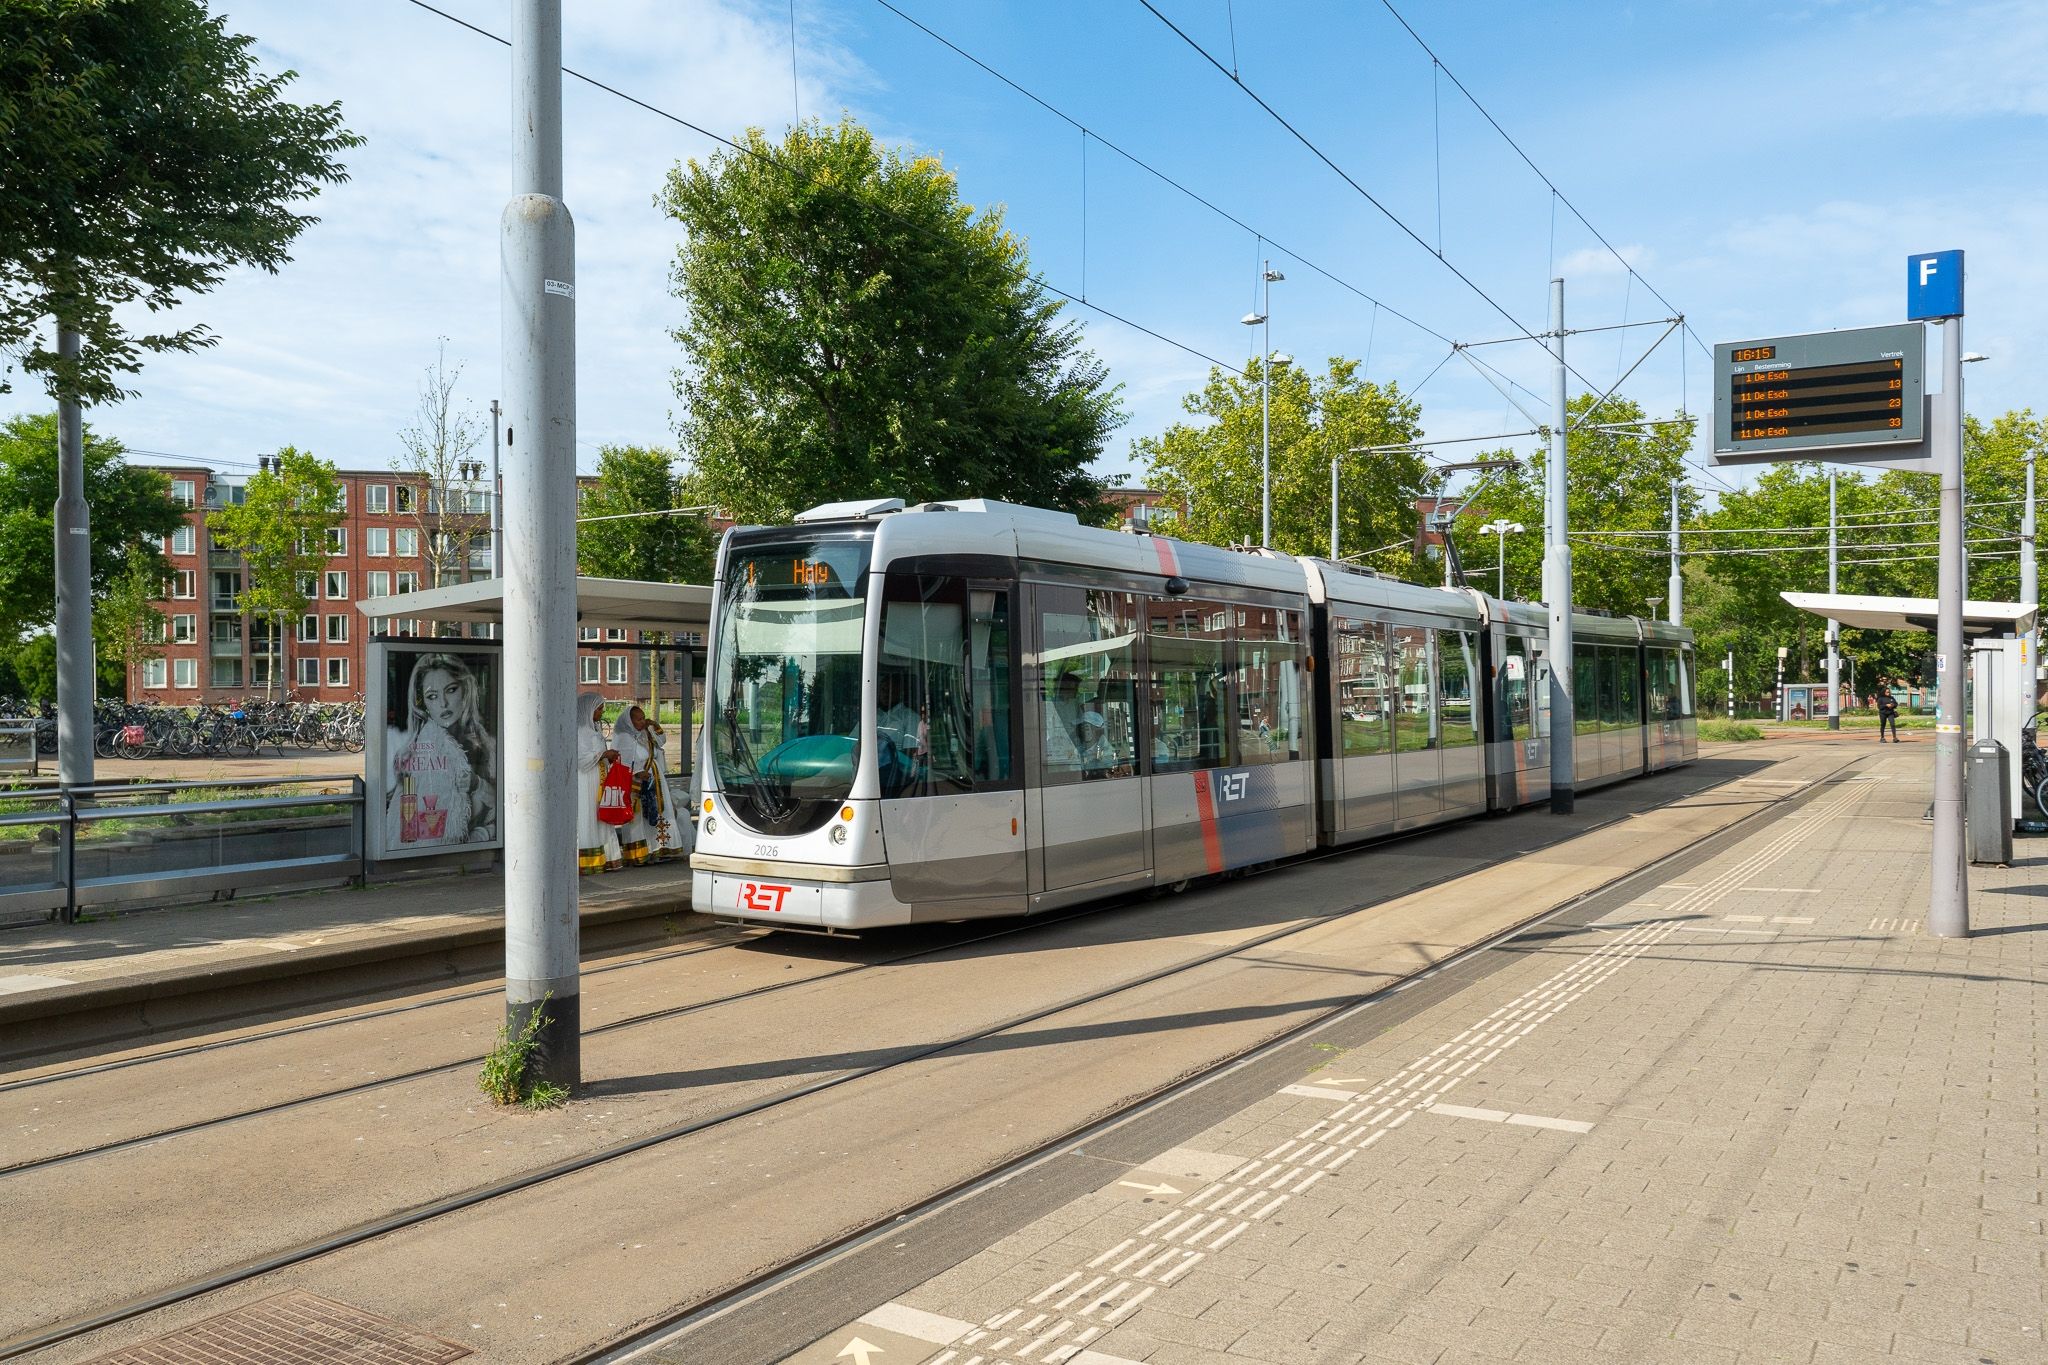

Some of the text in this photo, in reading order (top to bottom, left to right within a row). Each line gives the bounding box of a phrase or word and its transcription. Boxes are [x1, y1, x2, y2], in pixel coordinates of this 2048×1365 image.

[1920, 259, 1937, 286] F
[1736, 348, 1770, 361] 16:15
[1754, 362, 1792, 371] Bestemming
[1880, 350, 1904, 358] Vertrek
[1754, 373, 1765, 381] De
[1767, 371, 1788, 380] Esch
[1895, 360, 1901, 369] 4
[1741, 380, 1901, 401] 11 De Esch 13
[1745, 399, 1901, 419] 1 De Esch 23
[1741, 418, 1901, 438] 11 De Esch 33
[1219, 772, 1250, 802] RET
[754, 844, 779, 857] 2026
[737, 883, 793, 912] RET
